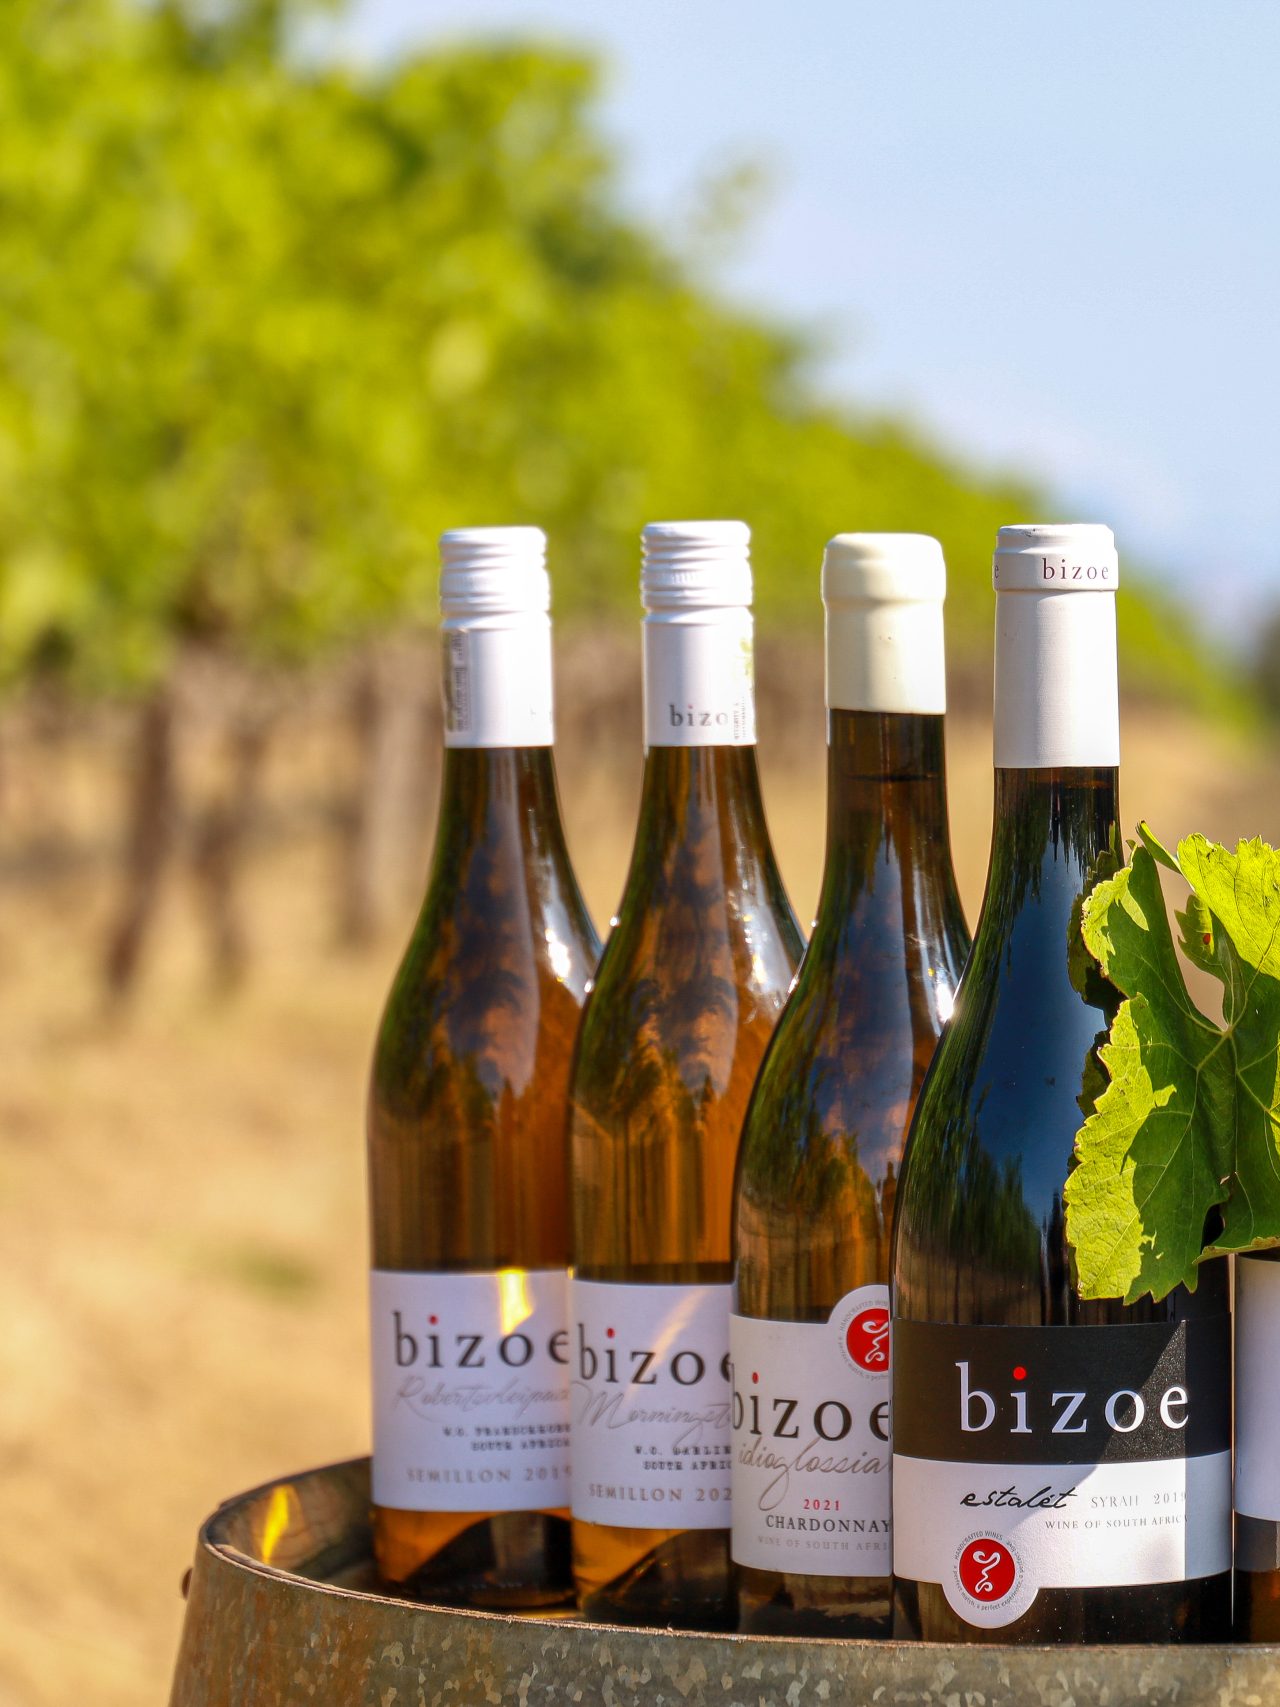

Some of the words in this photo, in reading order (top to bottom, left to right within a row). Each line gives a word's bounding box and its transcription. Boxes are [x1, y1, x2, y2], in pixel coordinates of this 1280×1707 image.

[1042, 558, 1109, 580] bizoe
[392, 1310, 569, 1368] bizoe
[955, 1361, 1189, 1434] bizoe
[643, 1461, 683, 1471] SOUTH
[738, 1436, 888, 1511] idioglossia
[407, 1467, 512, 1484] SEMILLON
[589, 1484, 682, 1501] SEMILLON
[960, 1485, 1079, 1510] estalét
[1091, 1494, 1139, 1509] SYRAH
[803, 1498, 841, 1511] 2021
[765, 1515, 890, 1533] CHARDONNAY
[1045, 1520, 1079, 1530] WINE
[1085, 1519, 1101, 1530] OF
[1106, 1517, 1147, 1529] SOUTH
[758, 1536, 782, 1546] WINE
[786, 1538, 800, 1547] OF
[805, 1540, 849, 1550] SOUTH
[955, 1531, 984, 1561] HANDCRAFTED
[984, 1530, 1003, 1541] WINES
